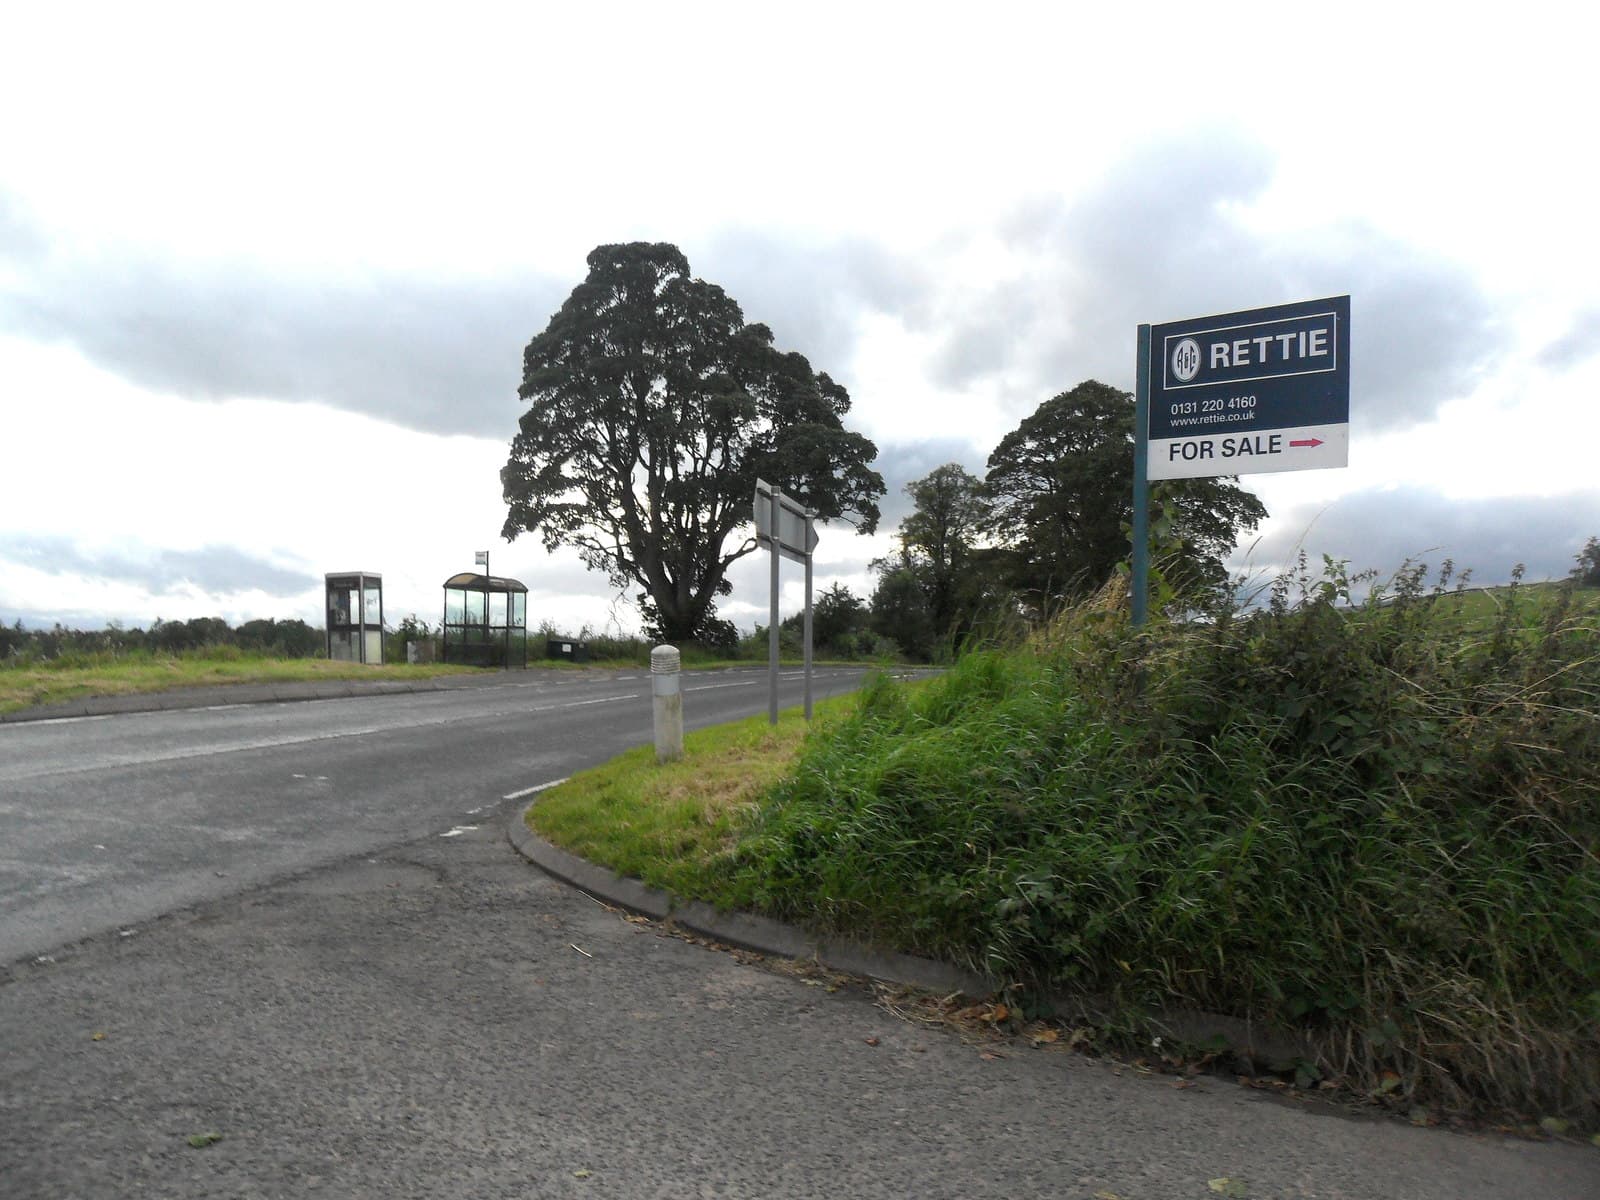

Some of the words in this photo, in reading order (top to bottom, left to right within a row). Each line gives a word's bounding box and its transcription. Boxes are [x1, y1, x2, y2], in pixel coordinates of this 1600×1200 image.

[1210, 329, 1328, 369] RETTIE
[1171, 402, 1197, 415] 0131
[1202, 399, 1224, 412] 220
[1228, 395, 1256, 409] 4160
[1170, 410, 1255, 427] www.rettie.co.uk
[1169, 440, 1214, 461] FOR
[1221, 434, 1282, 458] SALE
